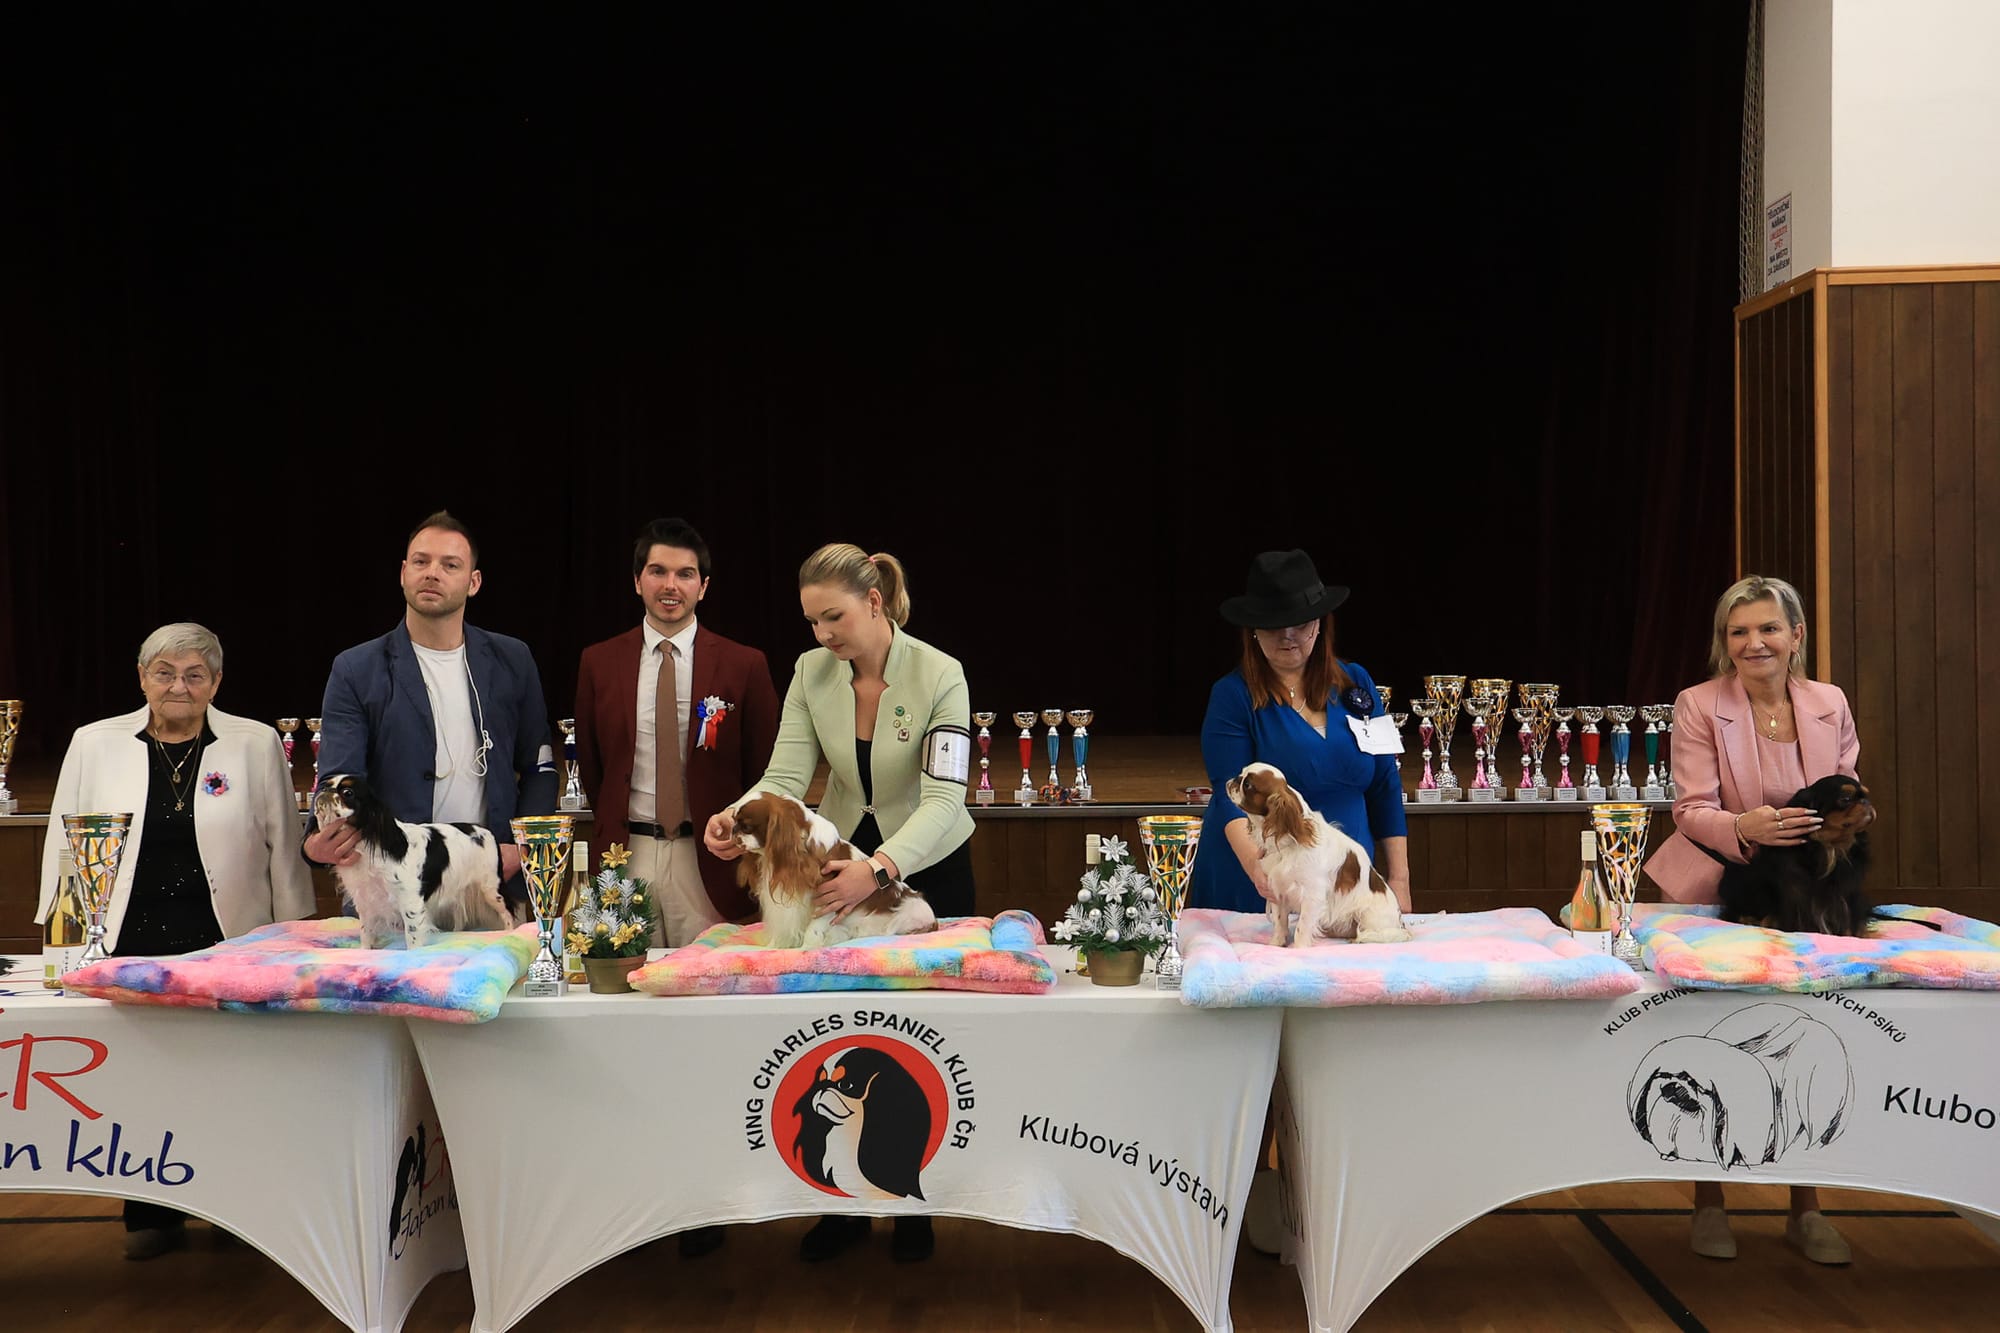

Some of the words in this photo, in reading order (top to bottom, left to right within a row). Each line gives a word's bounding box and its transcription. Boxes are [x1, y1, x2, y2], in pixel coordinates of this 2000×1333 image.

[941, 742, 949, 753] 4
[853, 1010, 947, 1055] SPANIEL
[1603, 1006, 1642, 1036] KLUB
[1802, 991, 1866, 1015] OVÝCH
[0, 1008, 108, 1120] R
[753, 1014, 844, 1090] CHARLES
[943, 1054, 975, 1111] KLUB
[745, 1097, 766, 1150] KING
[950, 1119, 977, 1149] ČR
[1019, 1115, 1140, 1166] Klubová
[66, 1119, 194, 1186] klub
[395, 1194, 444, 1260] Japan
